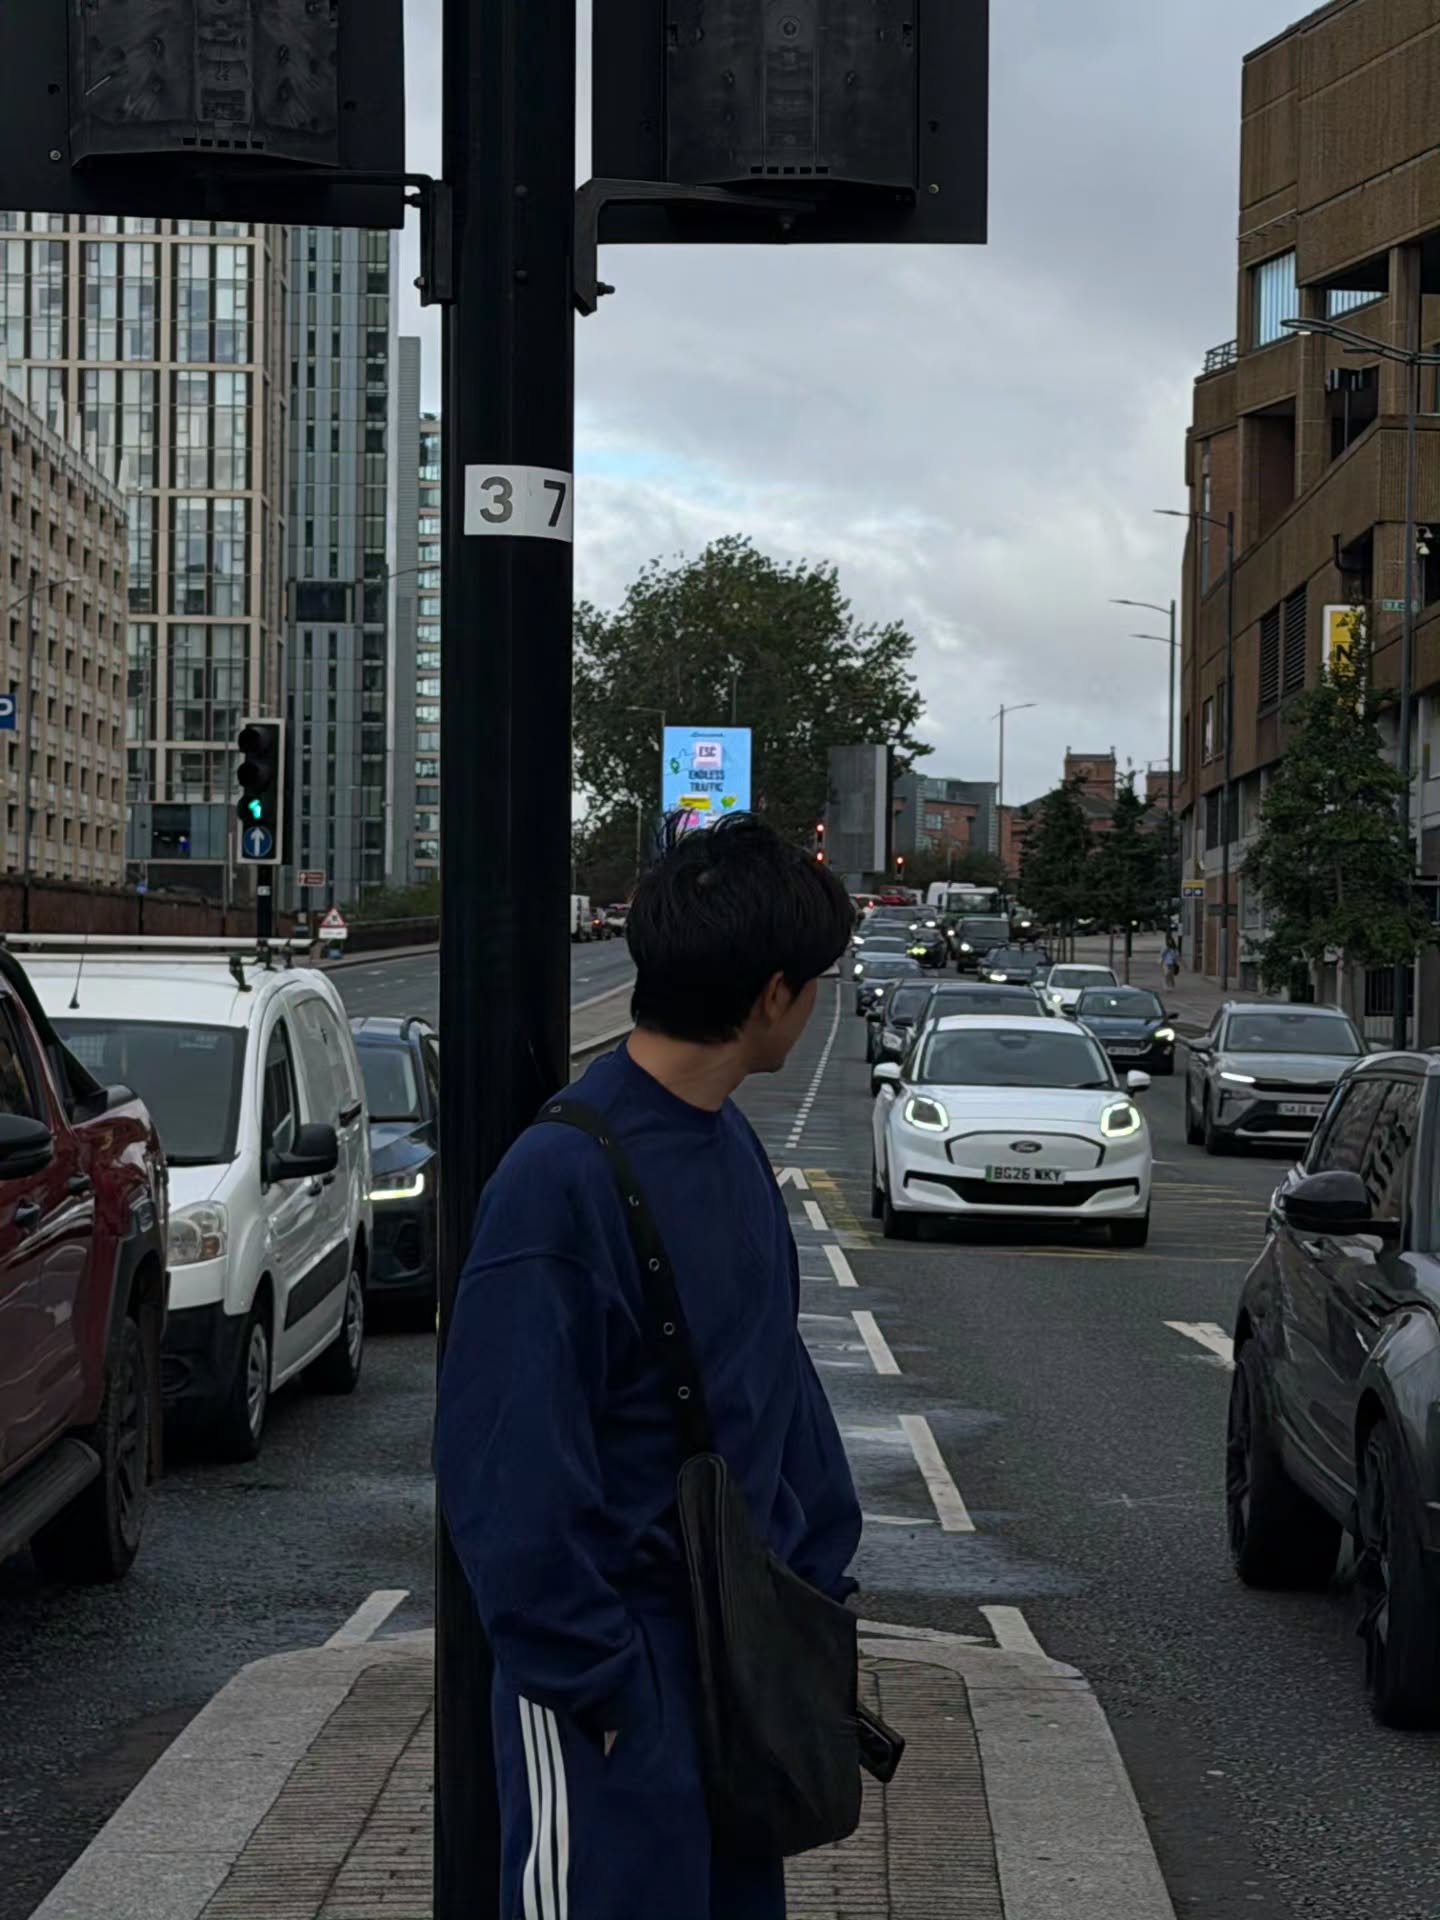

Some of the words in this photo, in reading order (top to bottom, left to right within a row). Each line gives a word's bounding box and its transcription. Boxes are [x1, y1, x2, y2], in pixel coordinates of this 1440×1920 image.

[699, 746, 717, 757] ESC
[688, 769, 725, 780] ENDLESS
[690, 782, 723, 792] TRAFFIC
